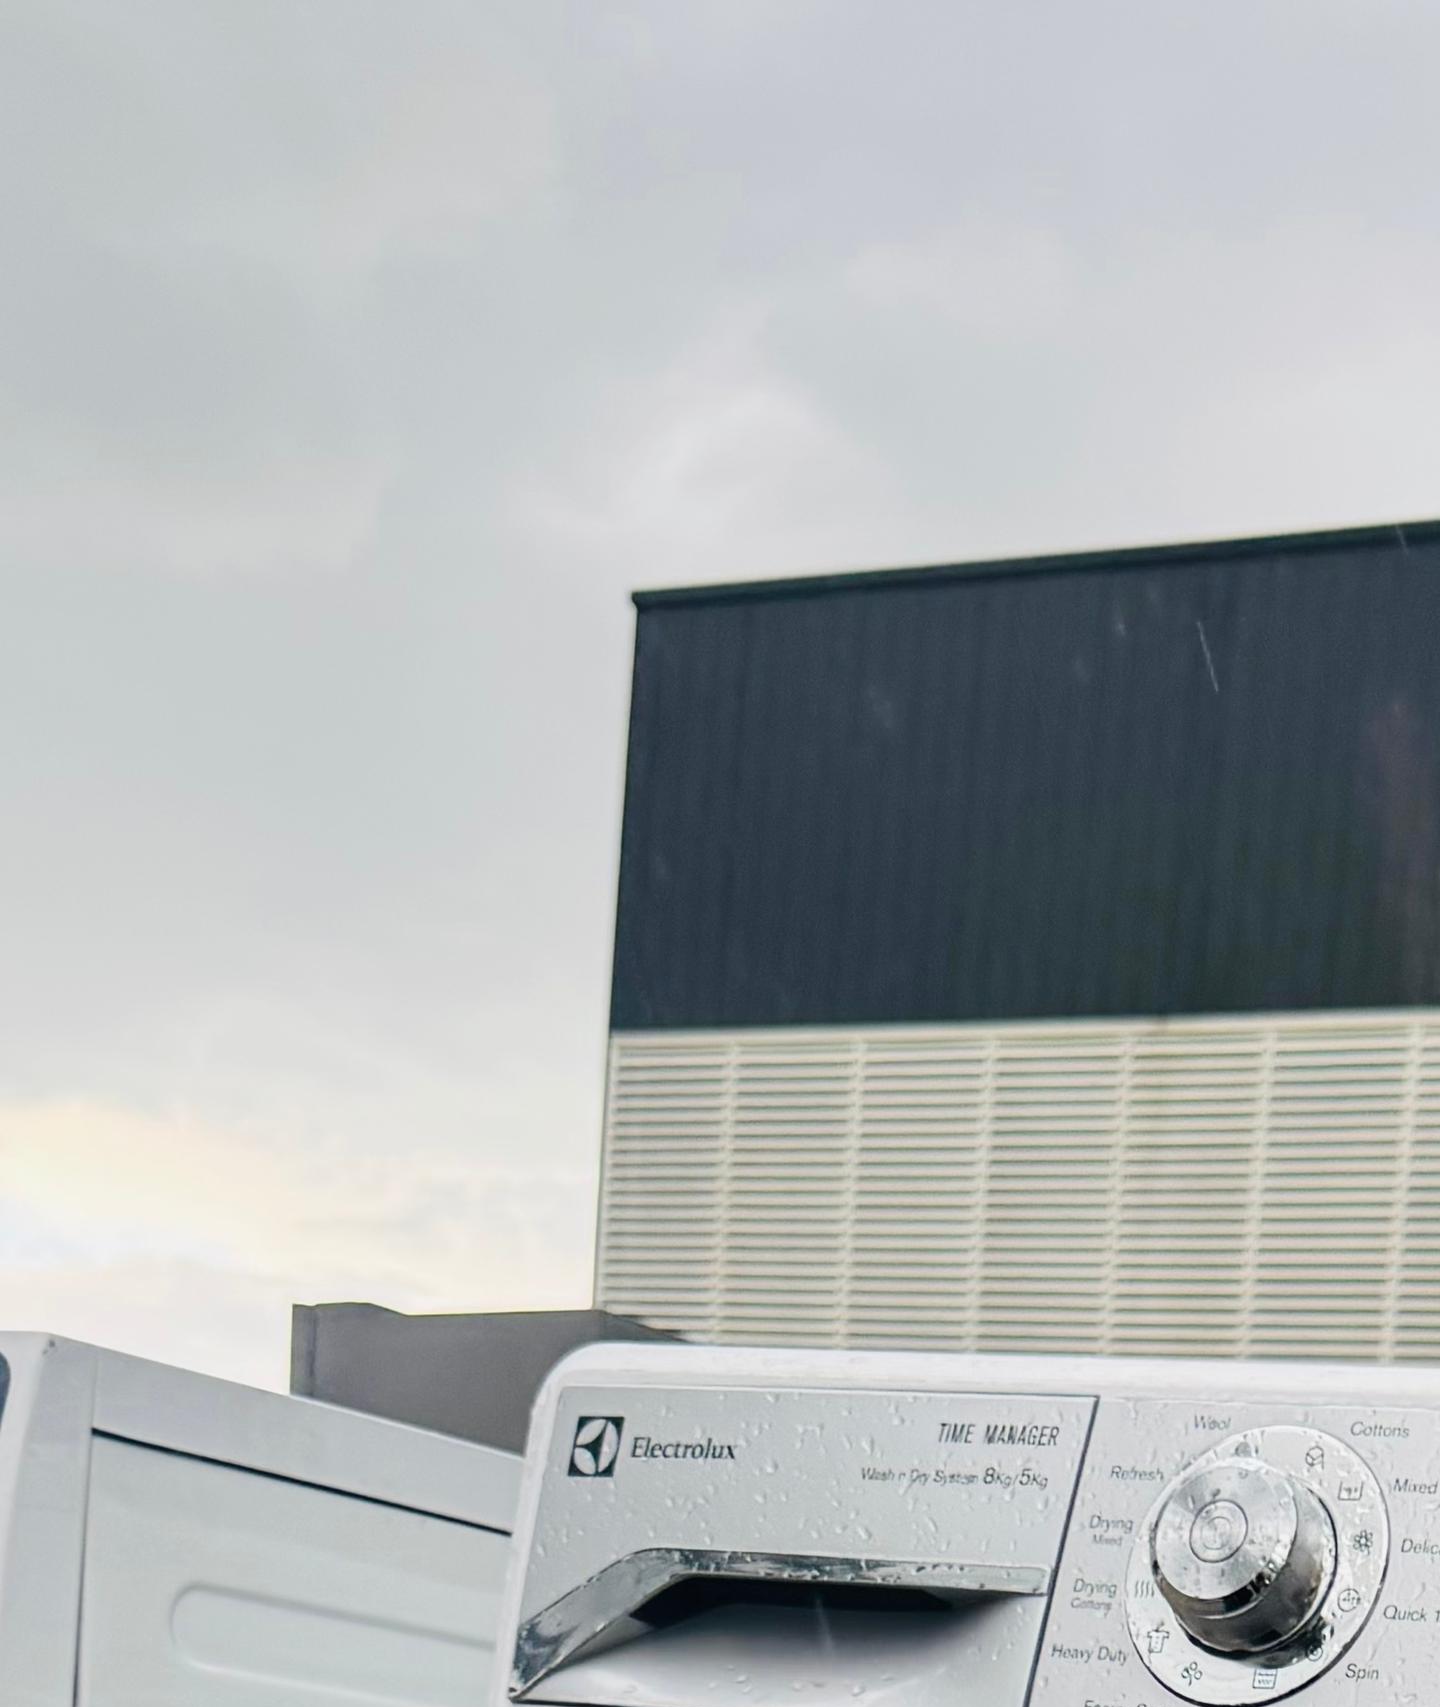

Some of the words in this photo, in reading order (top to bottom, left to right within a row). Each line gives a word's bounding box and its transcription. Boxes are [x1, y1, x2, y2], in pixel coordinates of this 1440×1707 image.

[938, 1423, 975, 1444] TIME
[984, 1424, 1060, 1446] MANAGER
[1350, 1421, 1410, 1438] Cottons
[631, 1436, 736, 1460] Electrolux
[1110, 1465, 1164, 1481] Refresh
[1393, 1478, 1439, 1495] Mixed
[1089, 1514, 1134, 1534] Drying
[1073, 1578, 1117, 1598] Drying
[1383, 1604, 1427, 1622] Quick
[1050, 1643, 1093, 1662] Heavy
[1097, 1646, 1128, 1666] Duty
[1345, 1663, 1380, 1682] Spin
